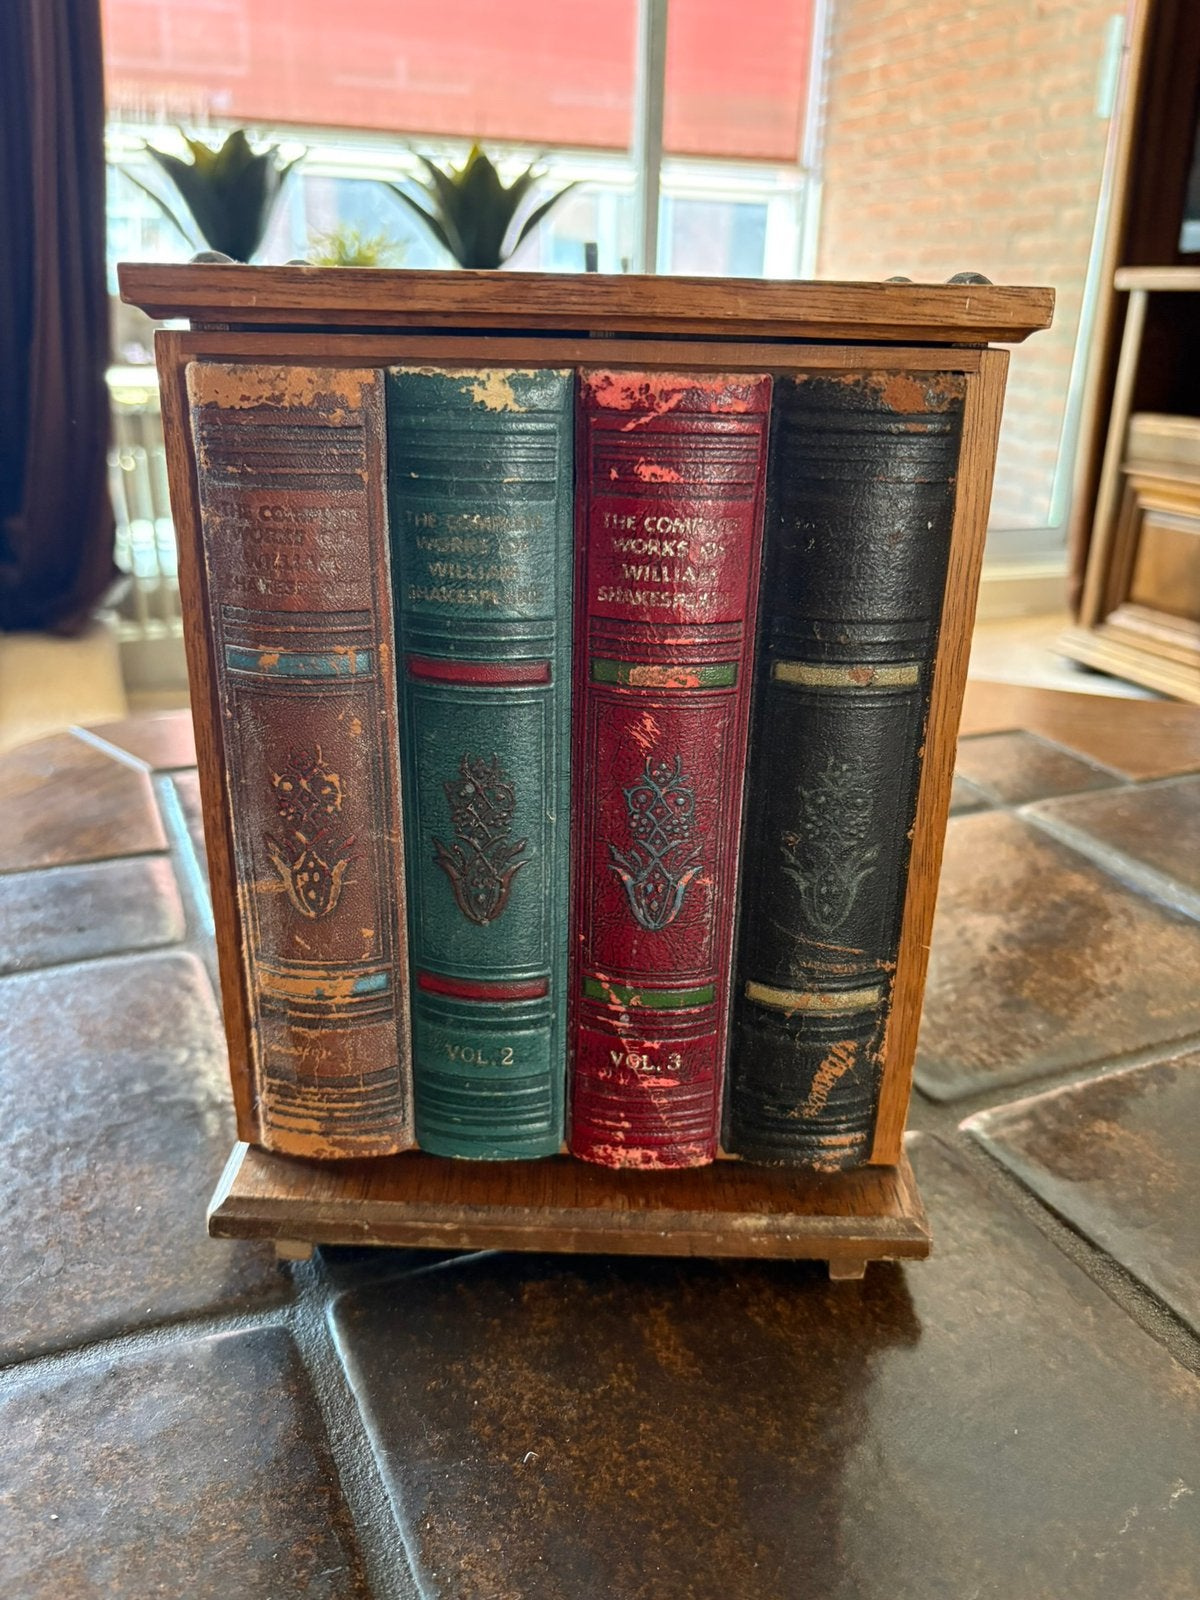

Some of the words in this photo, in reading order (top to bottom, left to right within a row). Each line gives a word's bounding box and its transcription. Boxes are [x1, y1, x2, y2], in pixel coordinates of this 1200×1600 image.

[406, 510, 437, 528] THE
[603, 512, 637, 531] THE
[612, 537, 690, 558] WORKS
[444, 1044, 498, 1067] VOL.
[501, 1047, 514, 1065] 2
[610, 1050, 661, 1071] VOL.
[666, 1052, 681, 1070] 3
